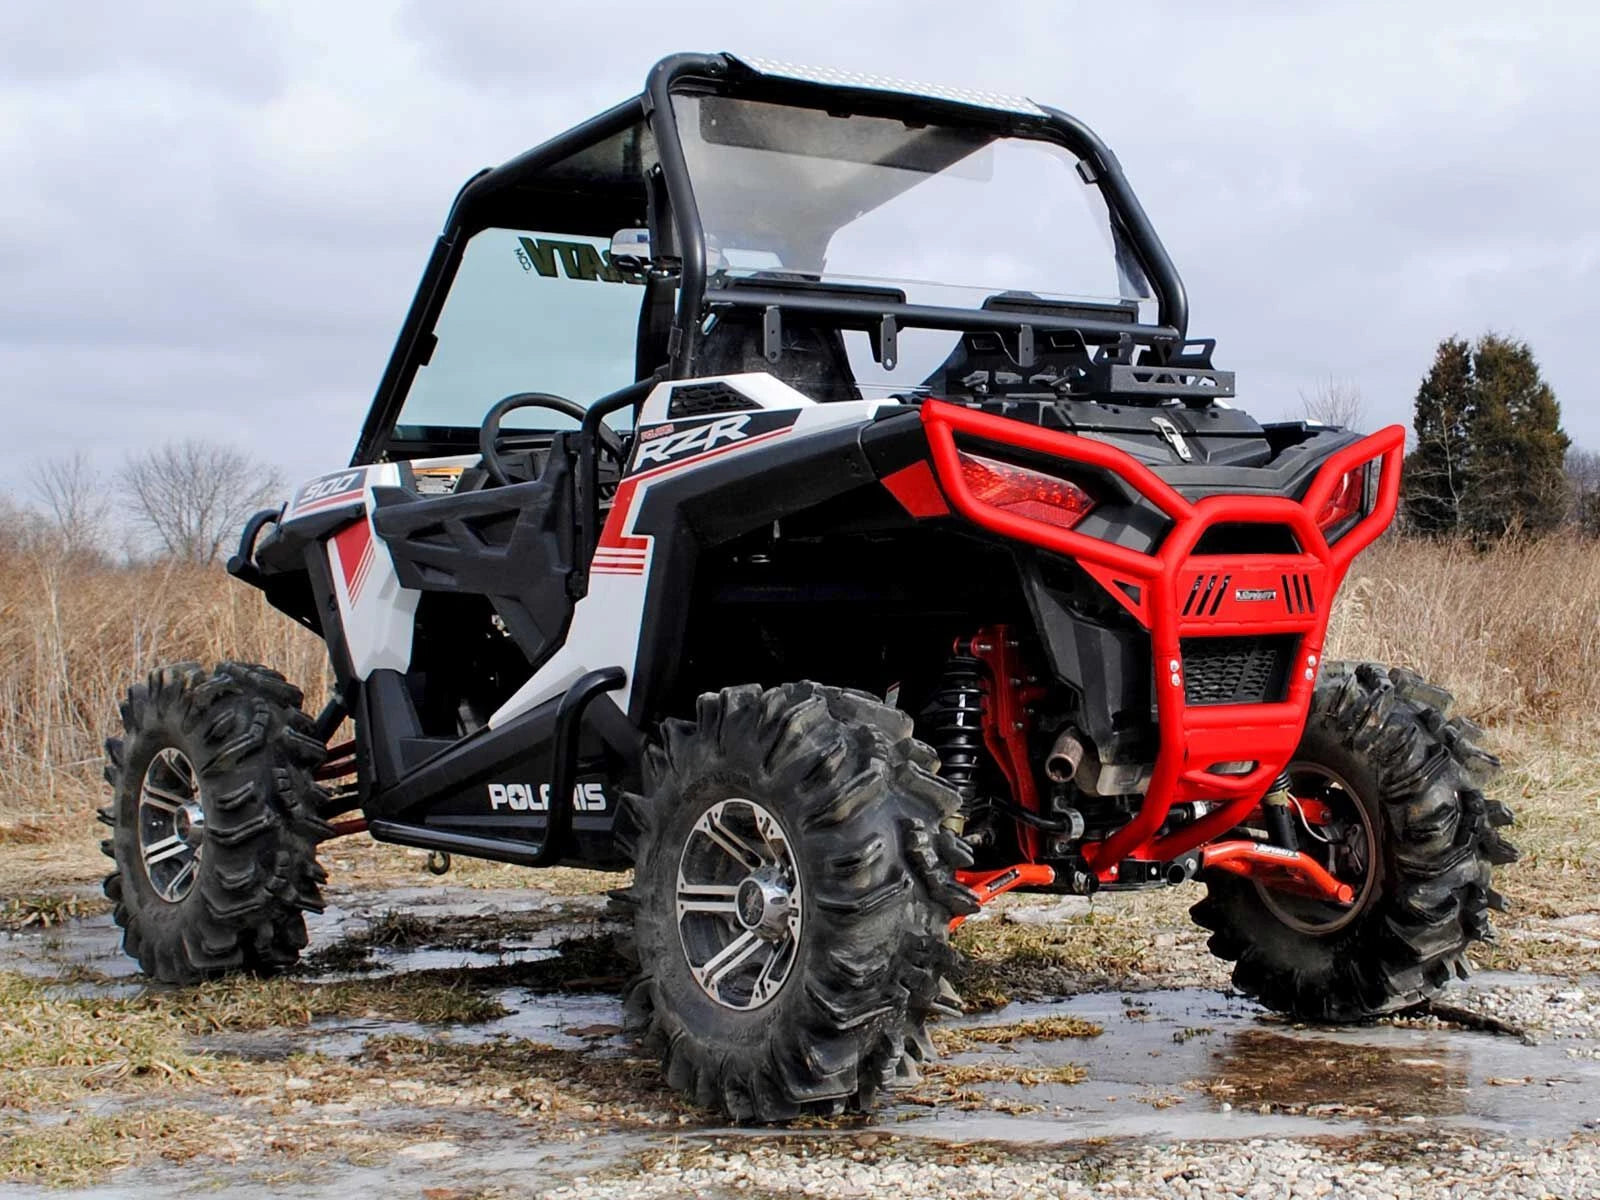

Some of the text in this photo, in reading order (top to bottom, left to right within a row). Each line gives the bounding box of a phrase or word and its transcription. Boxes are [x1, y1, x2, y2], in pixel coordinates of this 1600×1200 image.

[632, 414, 751, 472] RZR
[303, 473, 361, 499] 900
[488, 783, 607, 811] POLIS
